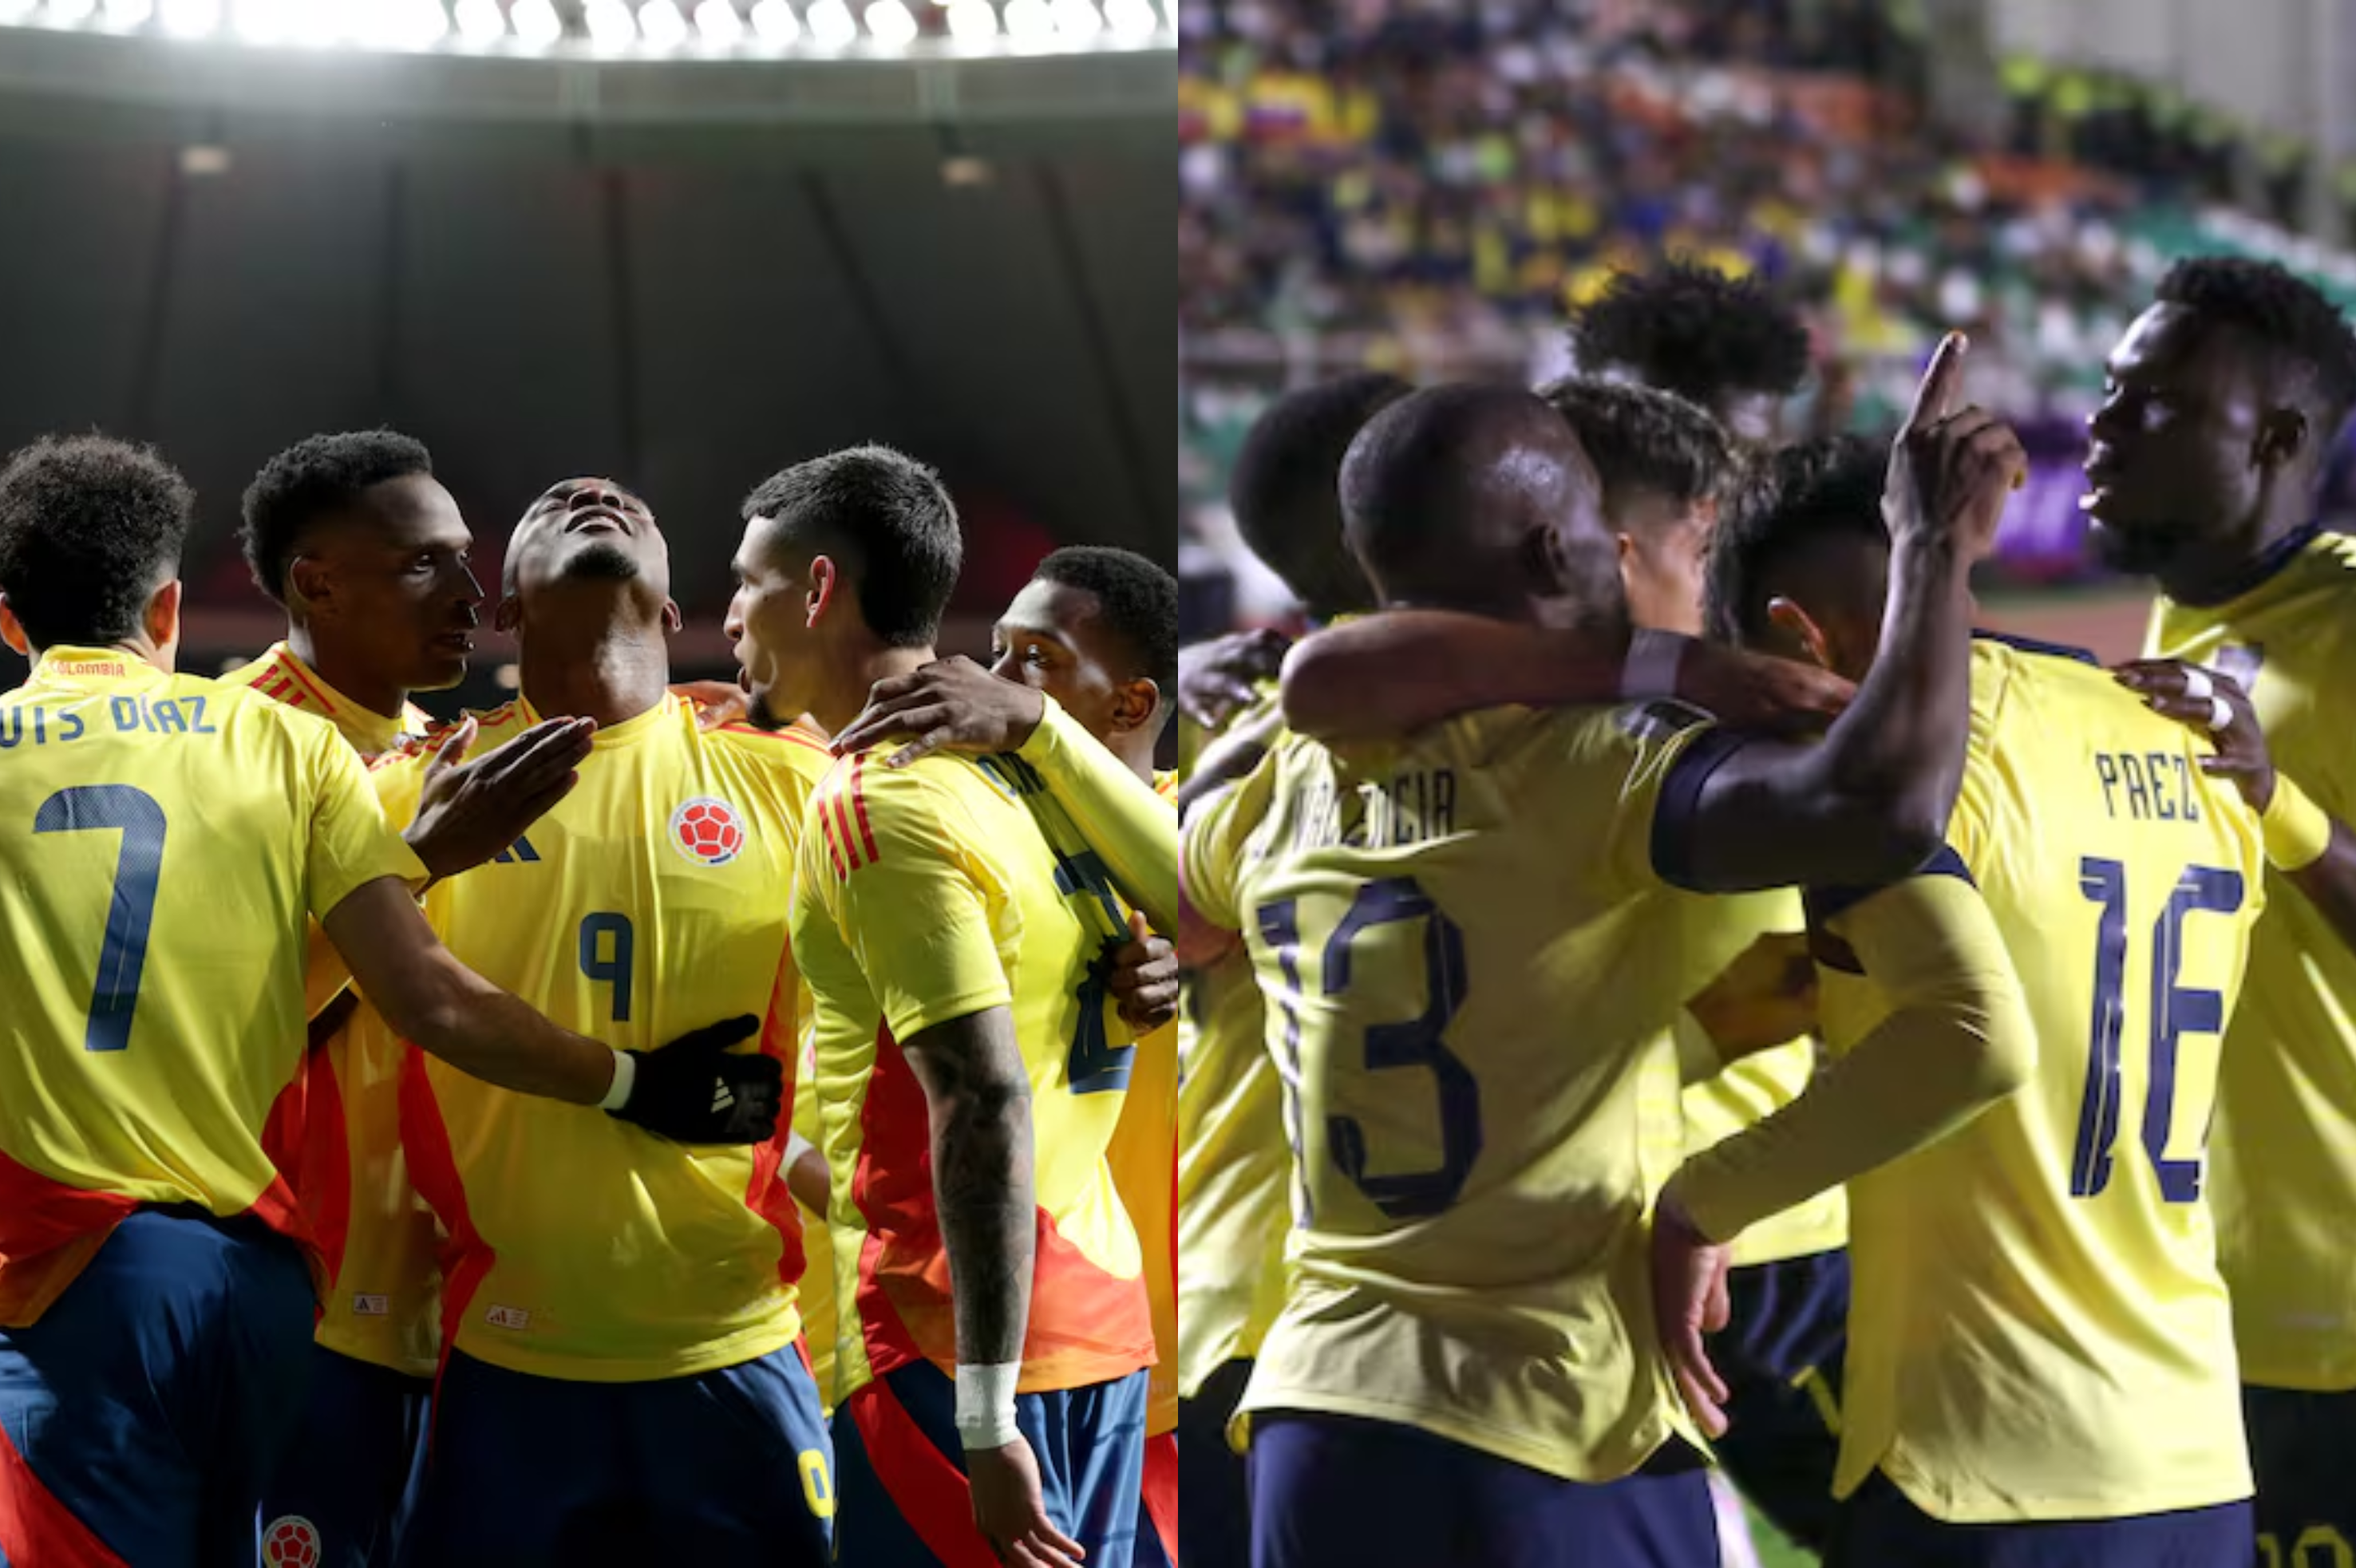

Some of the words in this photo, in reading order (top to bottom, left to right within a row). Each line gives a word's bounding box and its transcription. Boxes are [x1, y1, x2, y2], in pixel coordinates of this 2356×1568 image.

[2095, 751, 2199, 823] PAEZ
[33, 784, 167, 1051] 7
[579, 911, 634, 1022] 9
[1256, 875, 1484, 1230] 13
